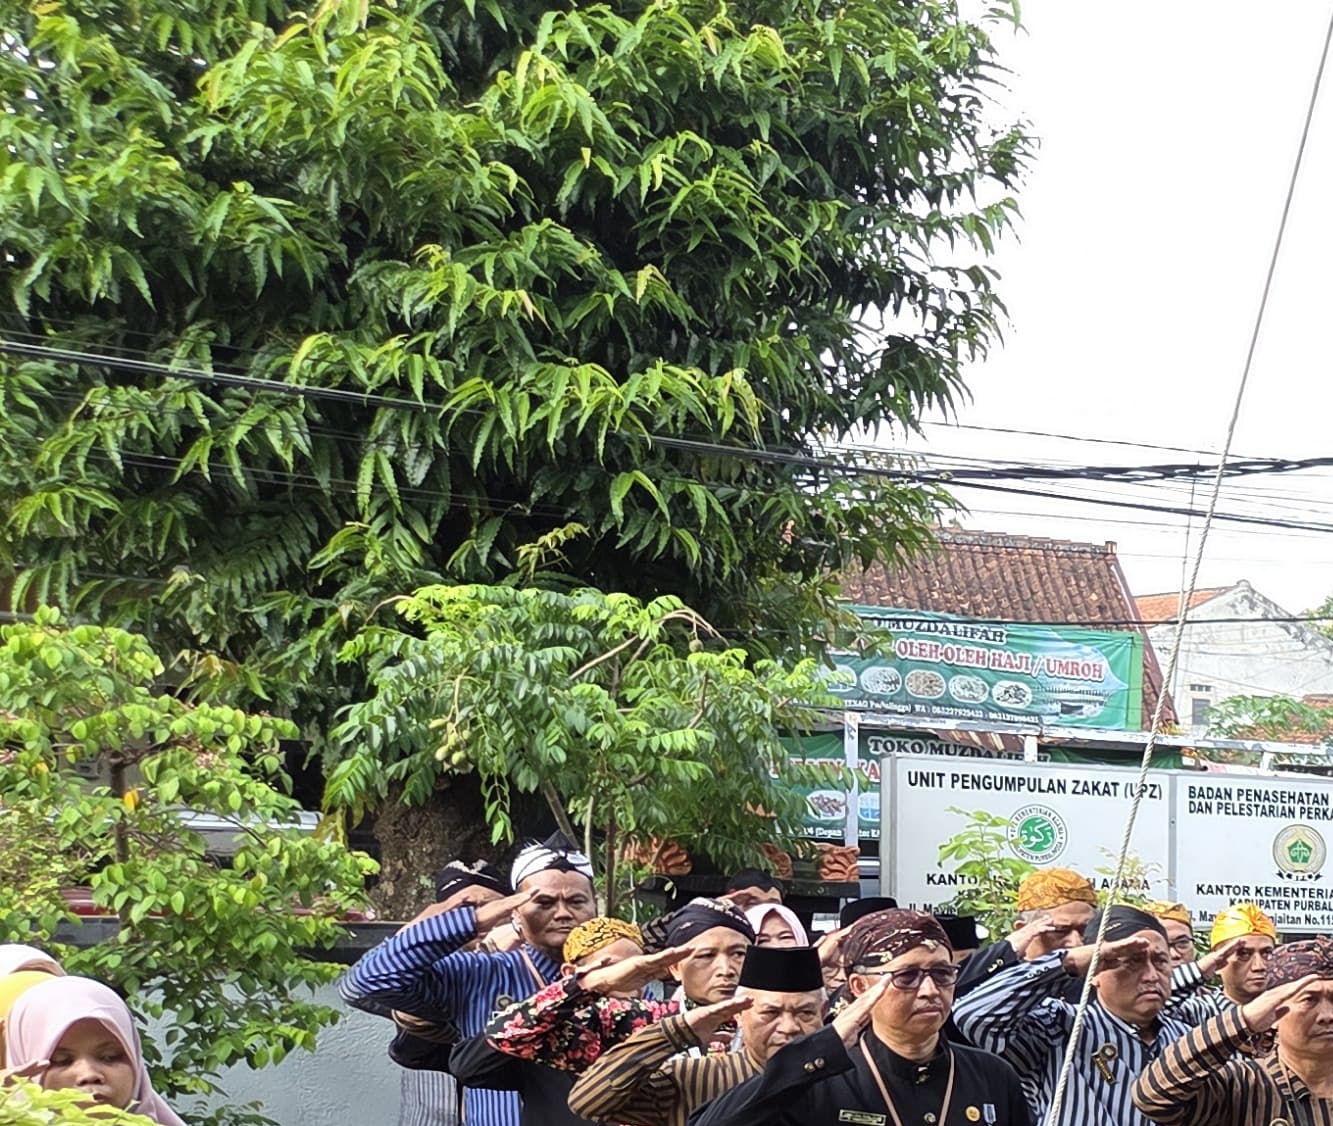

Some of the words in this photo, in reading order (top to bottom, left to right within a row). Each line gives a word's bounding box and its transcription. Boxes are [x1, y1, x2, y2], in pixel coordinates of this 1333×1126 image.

[898, 640, 987, 666] OLEH-OLEH
[990, 652, 1031, 674] HAJI
[1046, 657, 1105, 679] UMROH
[870, 738, 925, 754] TOKO
[908, 770, 946, 789] UNIT
[951, 773, 1067, 795] PENGUMPULAN
[1072, 779, 1120, 798] ZAKAT
[1188, 785, 1233, 802] BADAN
[1237, 789, 1328, 807] PENASEHATAN
[1188, 801, 1213, 815] DAN
[1216, 802, 1296, 819] PELESTARIAN
[926, 873, 979, 886] KANTO
[1196, 883, 1250, 897] KANTOR
